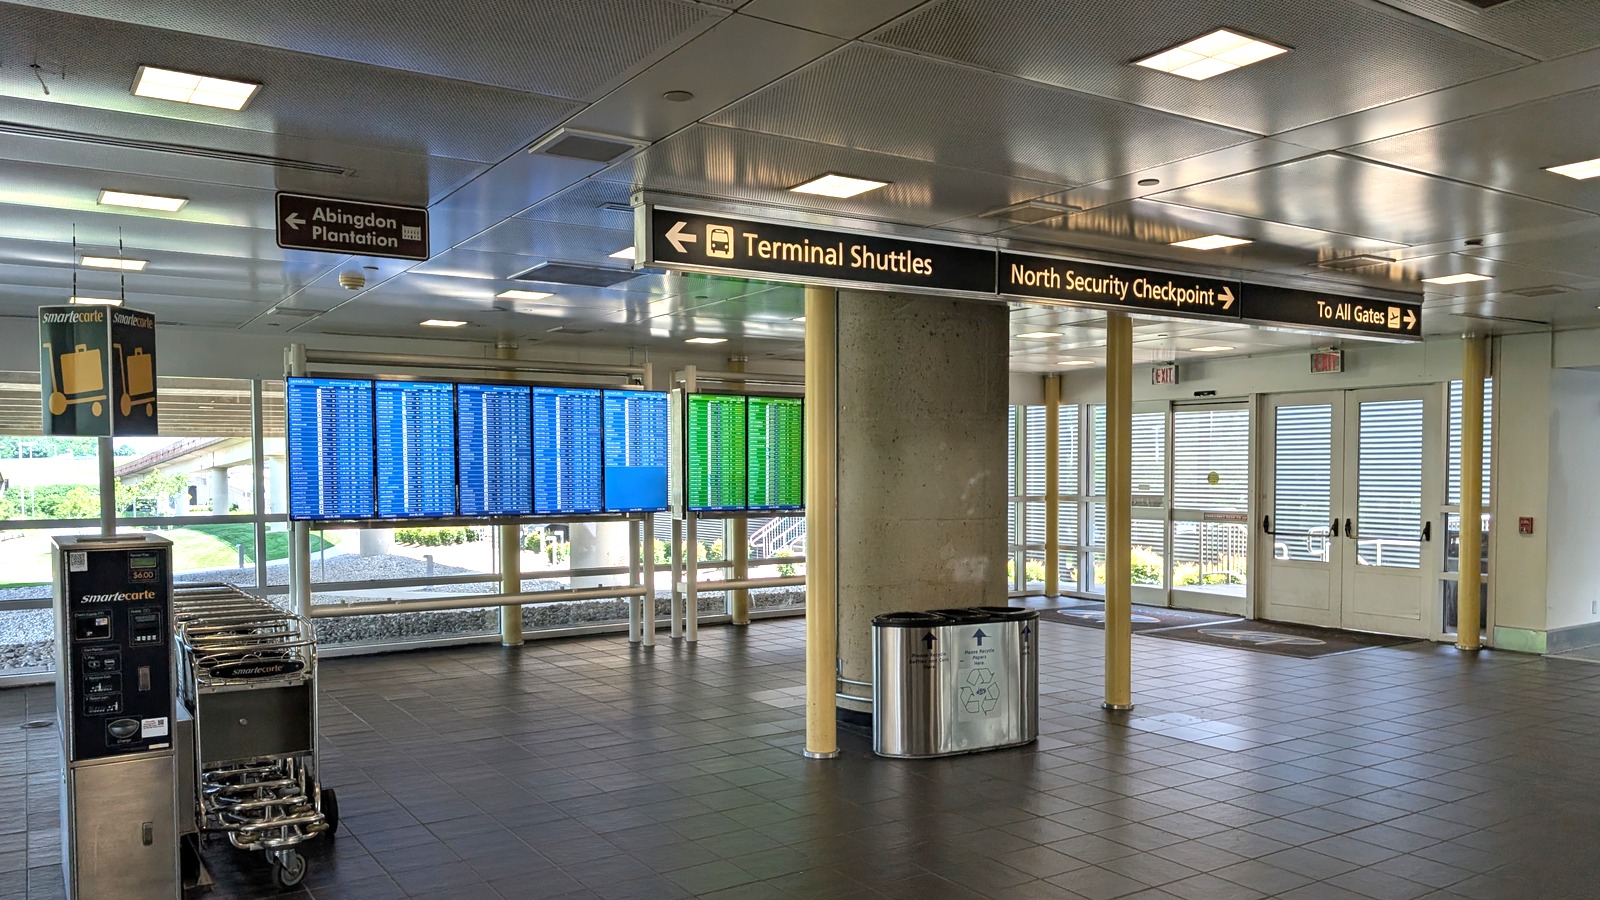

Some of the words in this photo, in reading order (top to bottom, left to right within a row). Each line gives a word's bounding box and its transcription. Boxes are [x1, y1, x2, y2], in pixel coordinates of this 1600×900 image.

[312, 207, 397, 229] Abingdon
[312, 226, 398, 248] Plantation
[743, 232, 843, 266] Terminal
[851, 245, 933, 275] Shuttles
[1011, 263, 1061, 289] North
[1066, 270, 1129, 301] Security
[1133, 278, 1215, 306] Checkpoint
[42, 310, 104, 323] smartecarte
[113, 312, 153, 329] smartecarte
[1317, 301, 1333, 318] To
[1335, 303, 1351, 321] All
[1354, 305, 1385, 325] Gates
[1314, 354, 1338, 372] EXIT
[1155, 367, 1174, 384] EXIT
[133, 571, 154, 579] $6.00
[80, 590, 155, 603] smartecarte
[232, 665, 283, 676] smartecarte
